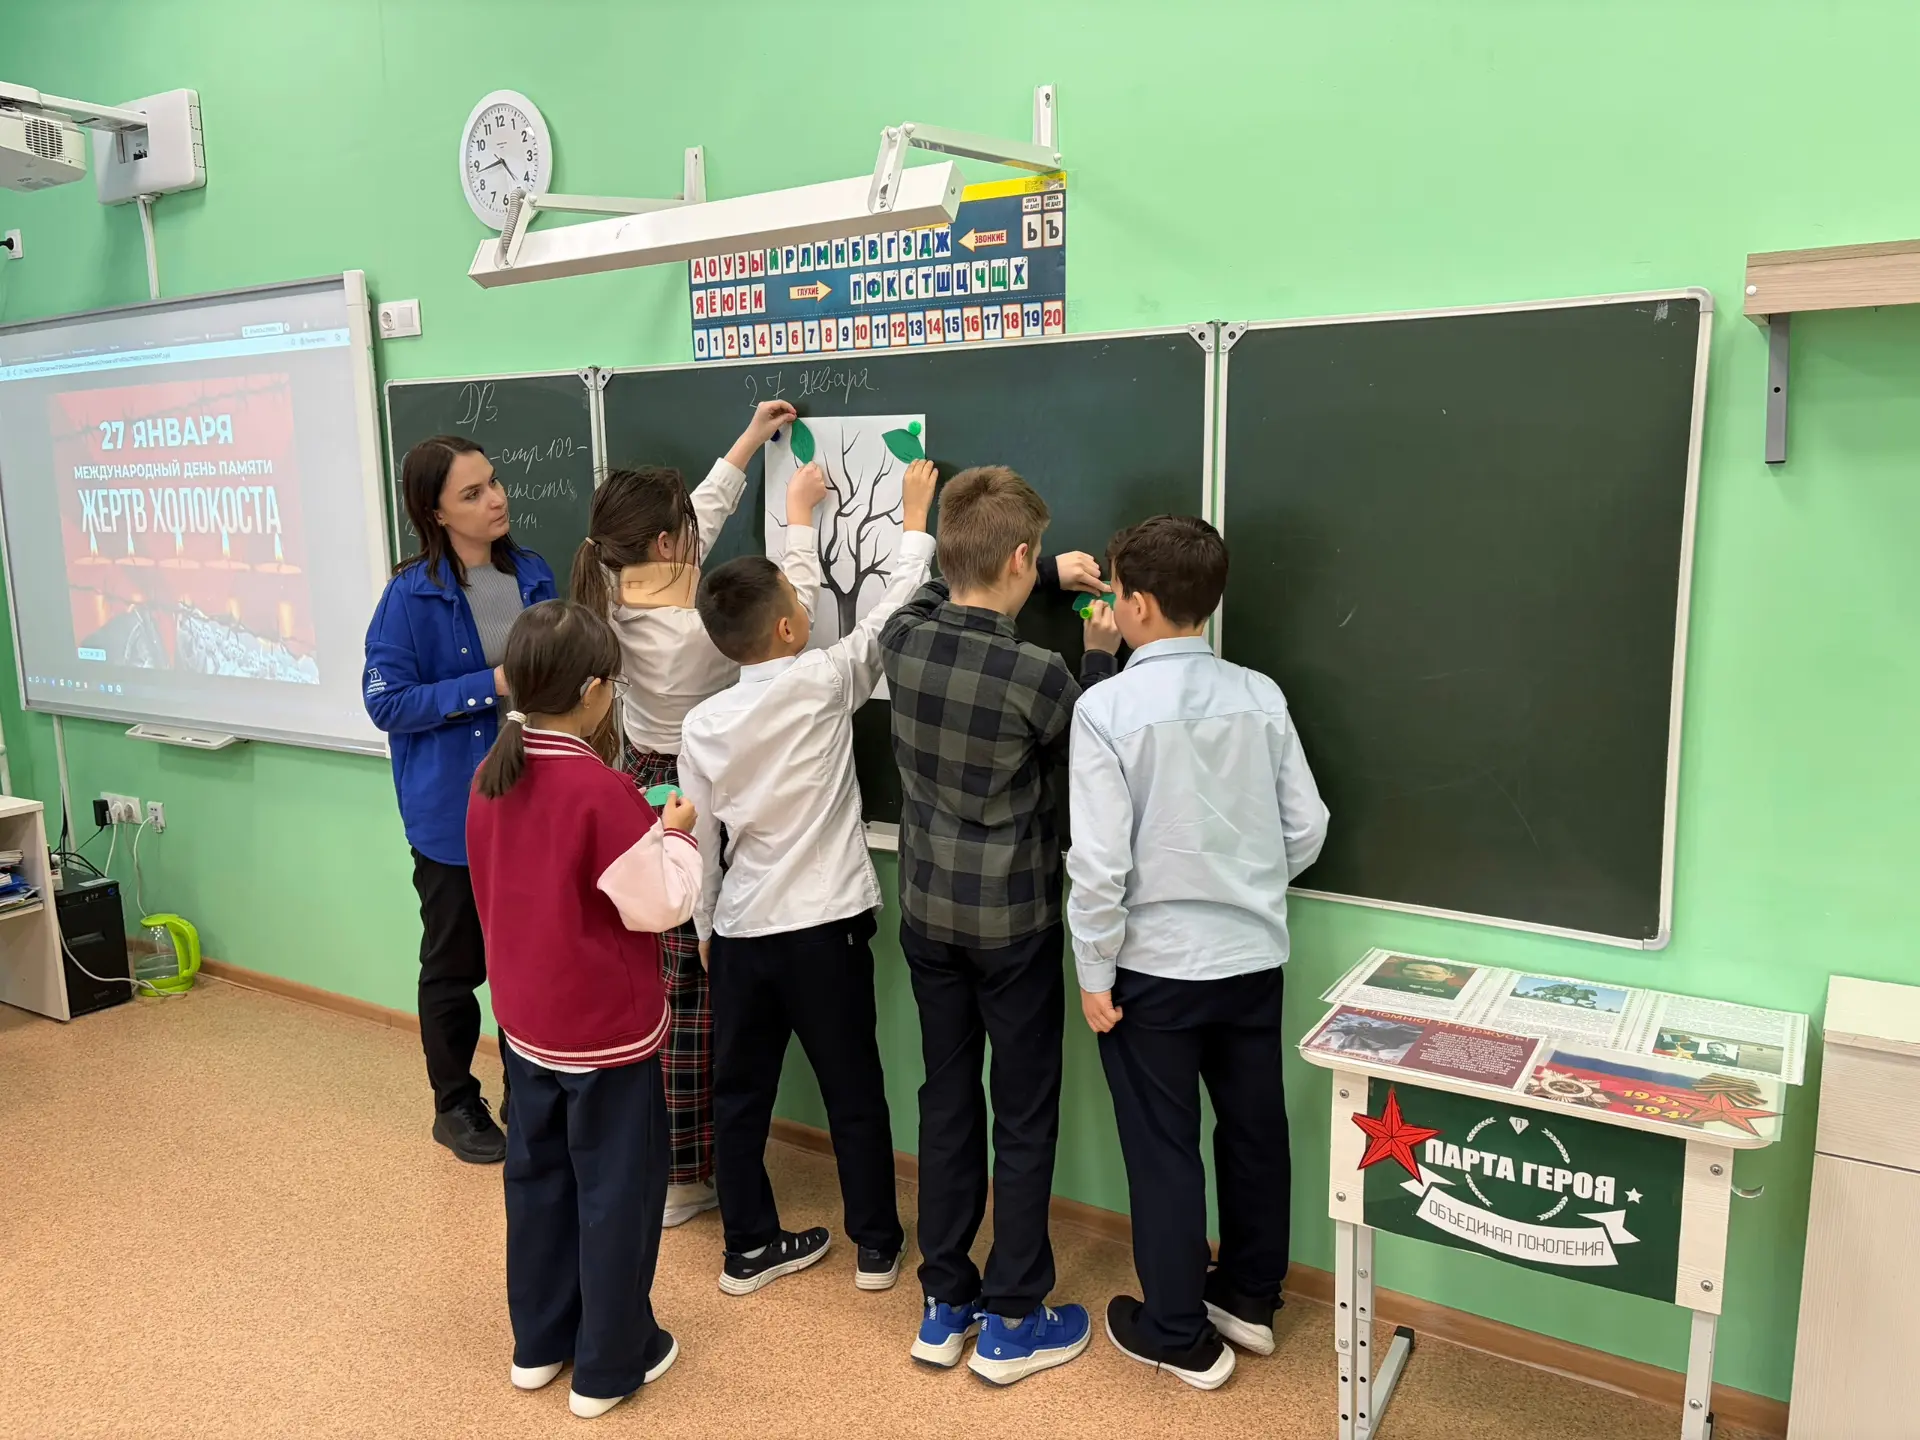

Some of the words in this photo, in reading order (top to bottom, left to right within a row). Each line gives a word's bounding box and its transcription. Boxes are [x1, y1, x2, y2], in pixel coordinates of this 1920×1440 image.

[495, 115, 505, 127] 12
[511, 119, 516, 130] 1
[484, 124, 492, 135] 11
[521, 131, 528, 142] 2
[477, 140, 486, 151] 10
[527, 150, 533, 161] 3
[474, 161, 480, 172] 9
[524, 171, 529, 182] 4
[480, 179, 485, 190] 8
[491, 191, 496, 202] 7
[503, 194, 509, 206] 6
[1027, 222, 1037, 241] Ь
[1046, 220, 1059, 239] Ъ
[974, 232, 1004, 244] ЗВОНКИЕ
[694, 261, 703, 279] А
[708, 259, 717, 276] О
[724, 257, 732, 275] У
[738, 255, 746, 273] Э
[751, 253, 764, 272] Ы
[786, 249, 794, 268] Р
[800, 247, 811, 266] Л
[817, 245, 828, 265] М
[835, 243, 844, 263] Н
[852, 241, 861, 262] Б
[868, 240, 878, 260] В
[887, 238, 895, 258] Г
[903, 235, 912, 256] З
[919, 234, 932, 258] Д
[936, 232, 950, 252] Ж
[853, 281, 861, 300] П
[867, 278, 881, 298] Ф
[887, 277, 897, 297] К
[906, 275, 914, 295] С
[922, 273, 931, 293] Т
[936, 272, 950, 292] Ш
[956, 270, 968, 292] Ц
[976, 267, 985, 288] Ч
[992, 265, 1008, 290] Щ
[1014, 264, 1025, 285] Х
[797, 286, 819, 297] ГЛУХИЕ
[696, 297, 704, 314] Я
[710, 292, 717, 313] Ё
[722, 293, 734, 312] Ю
[740, 292, 746, 310] Е
[754, 290, 762, 308] И
[697, 338, 704, 352] 0
[713, 336, 718, 350] 1
[728, 334, 734, 349] 2
[742, 333, 749, 348] 3
[759, 332, 766, 347] 4
[775, 331, 782, 345] 5
[792, 330, 798, 345] 6
[808, 328, 815, 344] 7
[825, 327, 832, 343] 8
[842, 326, 849, 341] 9
[856, 324, 867, 340] 10
[874, 323, 887, 339] 11
[892, 322, 905, 337] 12
[909, 320, 923, 336] 13
[927, 318, 941, 334] 14
[945, 316, 960, 333] 15
[965, 315, 979, 332] 16
[984, 314, 999, 330] 17
[1004, 312, 1019, 329] 18
[1024, 310, 1040, 327] 19
[1044, 309, 1061, 326] 20
[99, 422, 125, 450] 27
[133, 414, 234, 448] ЯНВАРЯ
[74, 460, 180, 481] МЕЖДУНАРОДНЫЙ
[183, 462, 216, 479] ДЕНЬ
[219, 460, 273, 476] ПАМЯТИ
[78, 489, 147, 533] ЖЕРТВ
[149, 486, 282, 534] ХОЛОКОСТА
[1425, 1138, 1515, 1182] ПАРТА
[1522, 1162, 1615, 1205] ГЕРОЯ
[1518, 1232, 1604, 1256] ПОКОЛЕНИЯ
